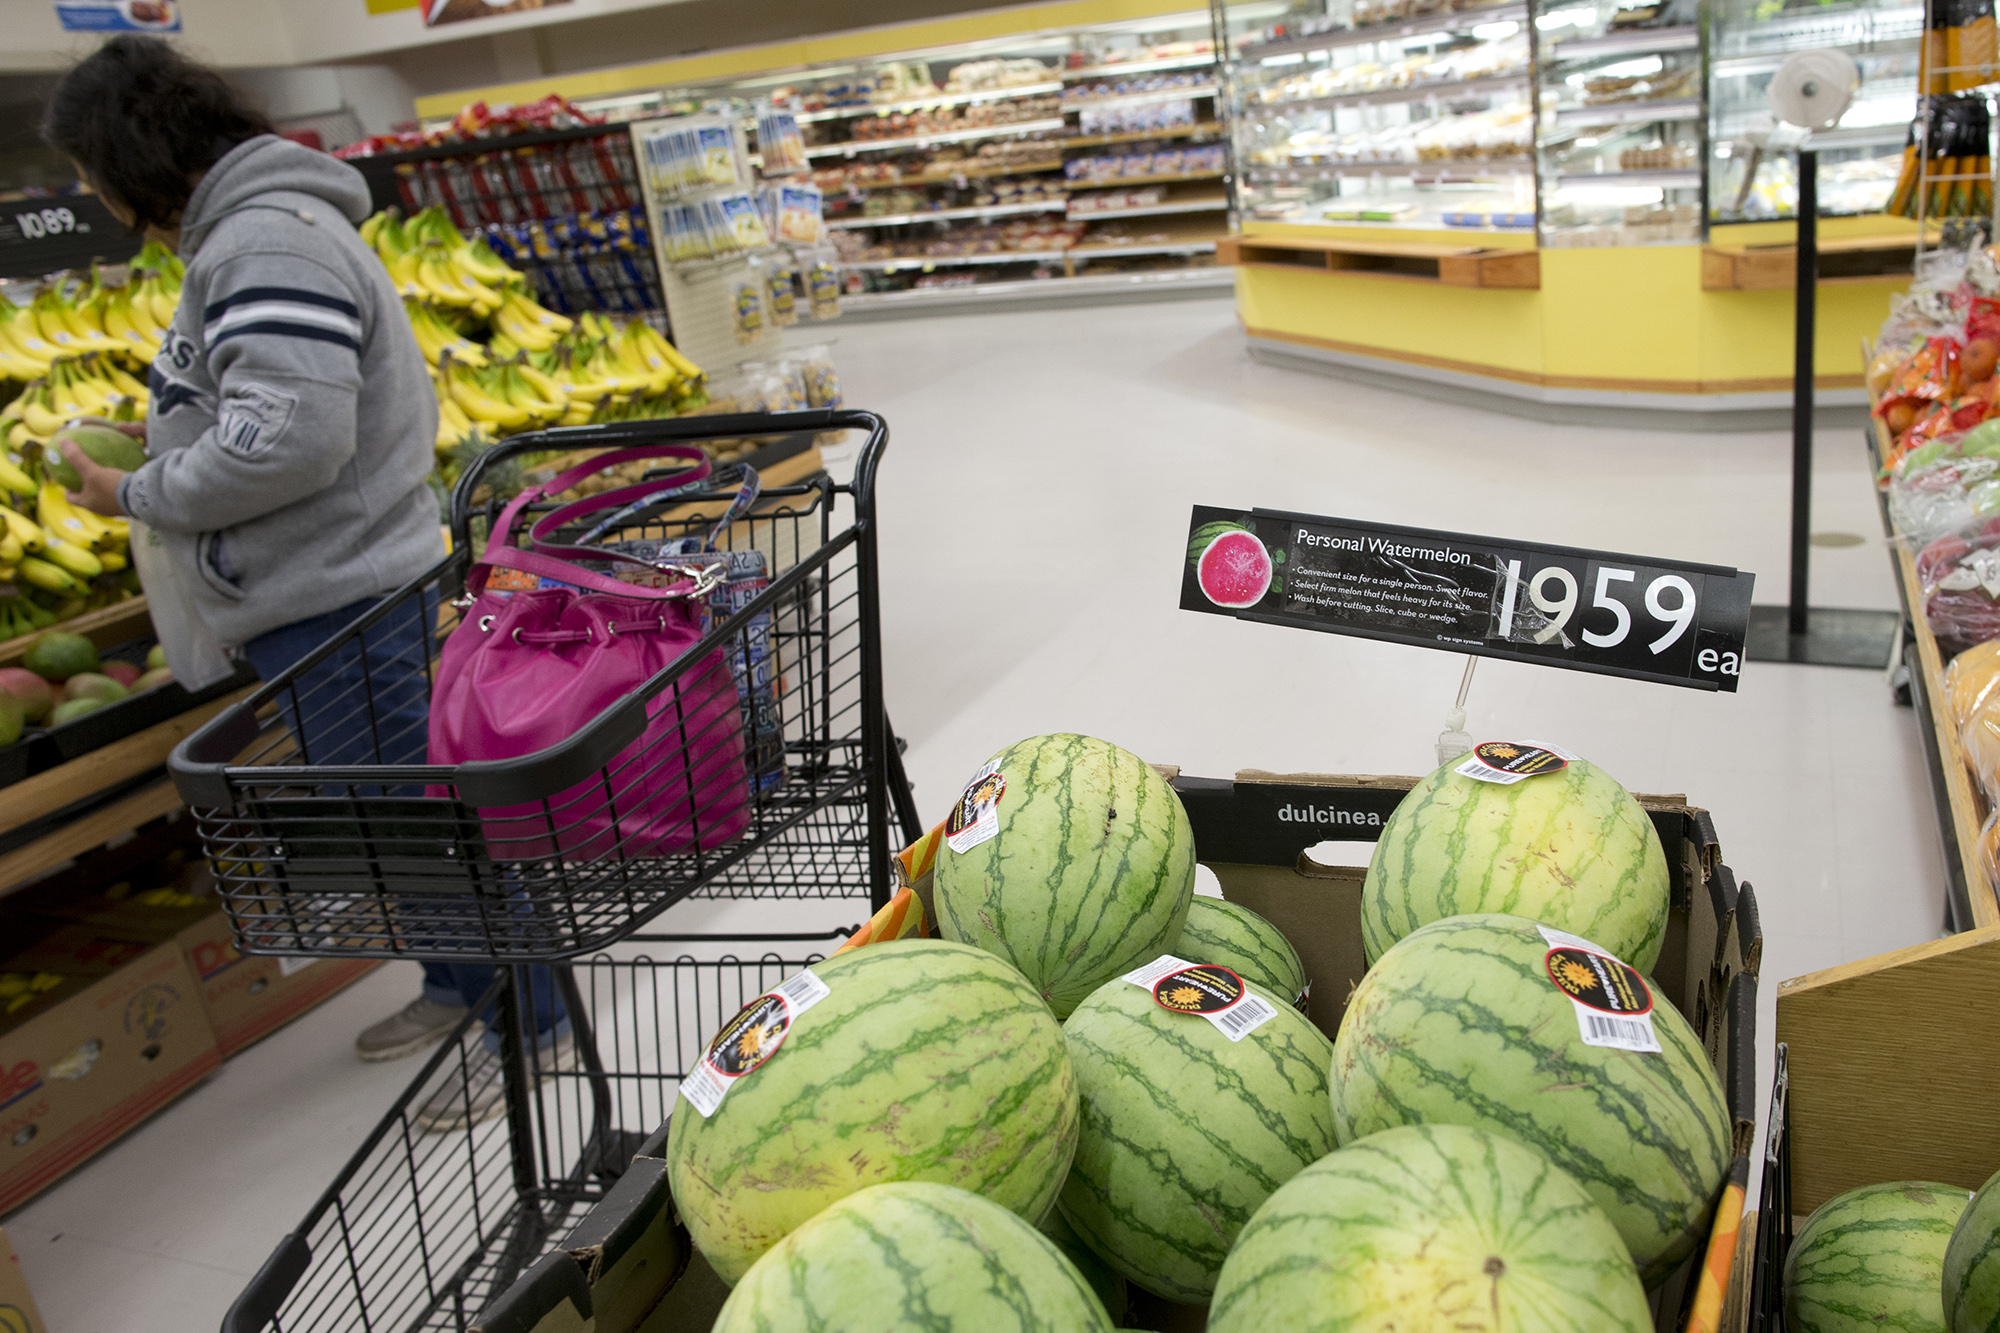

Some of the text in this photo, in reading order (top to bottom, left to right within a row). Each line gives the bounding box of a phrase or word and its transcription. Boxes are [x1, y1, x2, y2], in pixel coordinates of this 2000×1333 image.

[15, 207, 76, 239] 1089
[1297, 528, 1471, 565] Personal Watermelon
[1295, 579, 1473, 611] Select firm melon that feels heavy for its size.
[1297, 565, 1341, 580] Convenient
[1342, 572, 1358, 582] size
[1358, 574, 1371, 584] for
[1379, 578, 1403, 589] single
[1404, 582, 1434, 592] person.
[1436, 584, 1461, 595] Sweet
[1461, 587, 1488, 599] flavor.
[1293, 593, 1315, 603] Wash
[1316, 596, 1342, 607] before
[1343, 600, 1373, 613] cutting.
[1374, 604, 1396, 616] Slice,
[1397, 608, 1418, 618] cube
[1429, 612, 1458, 625] wedge.
[1452, 636, 1463, 644] sign
[1697, 647, 1740, 676] ea
[1172, 974, 1232, 1003] PURE HEART
[1549, 953, 1580, 995] DULCINEA
[1159, 990, 1202, 1010] DULCINEA
